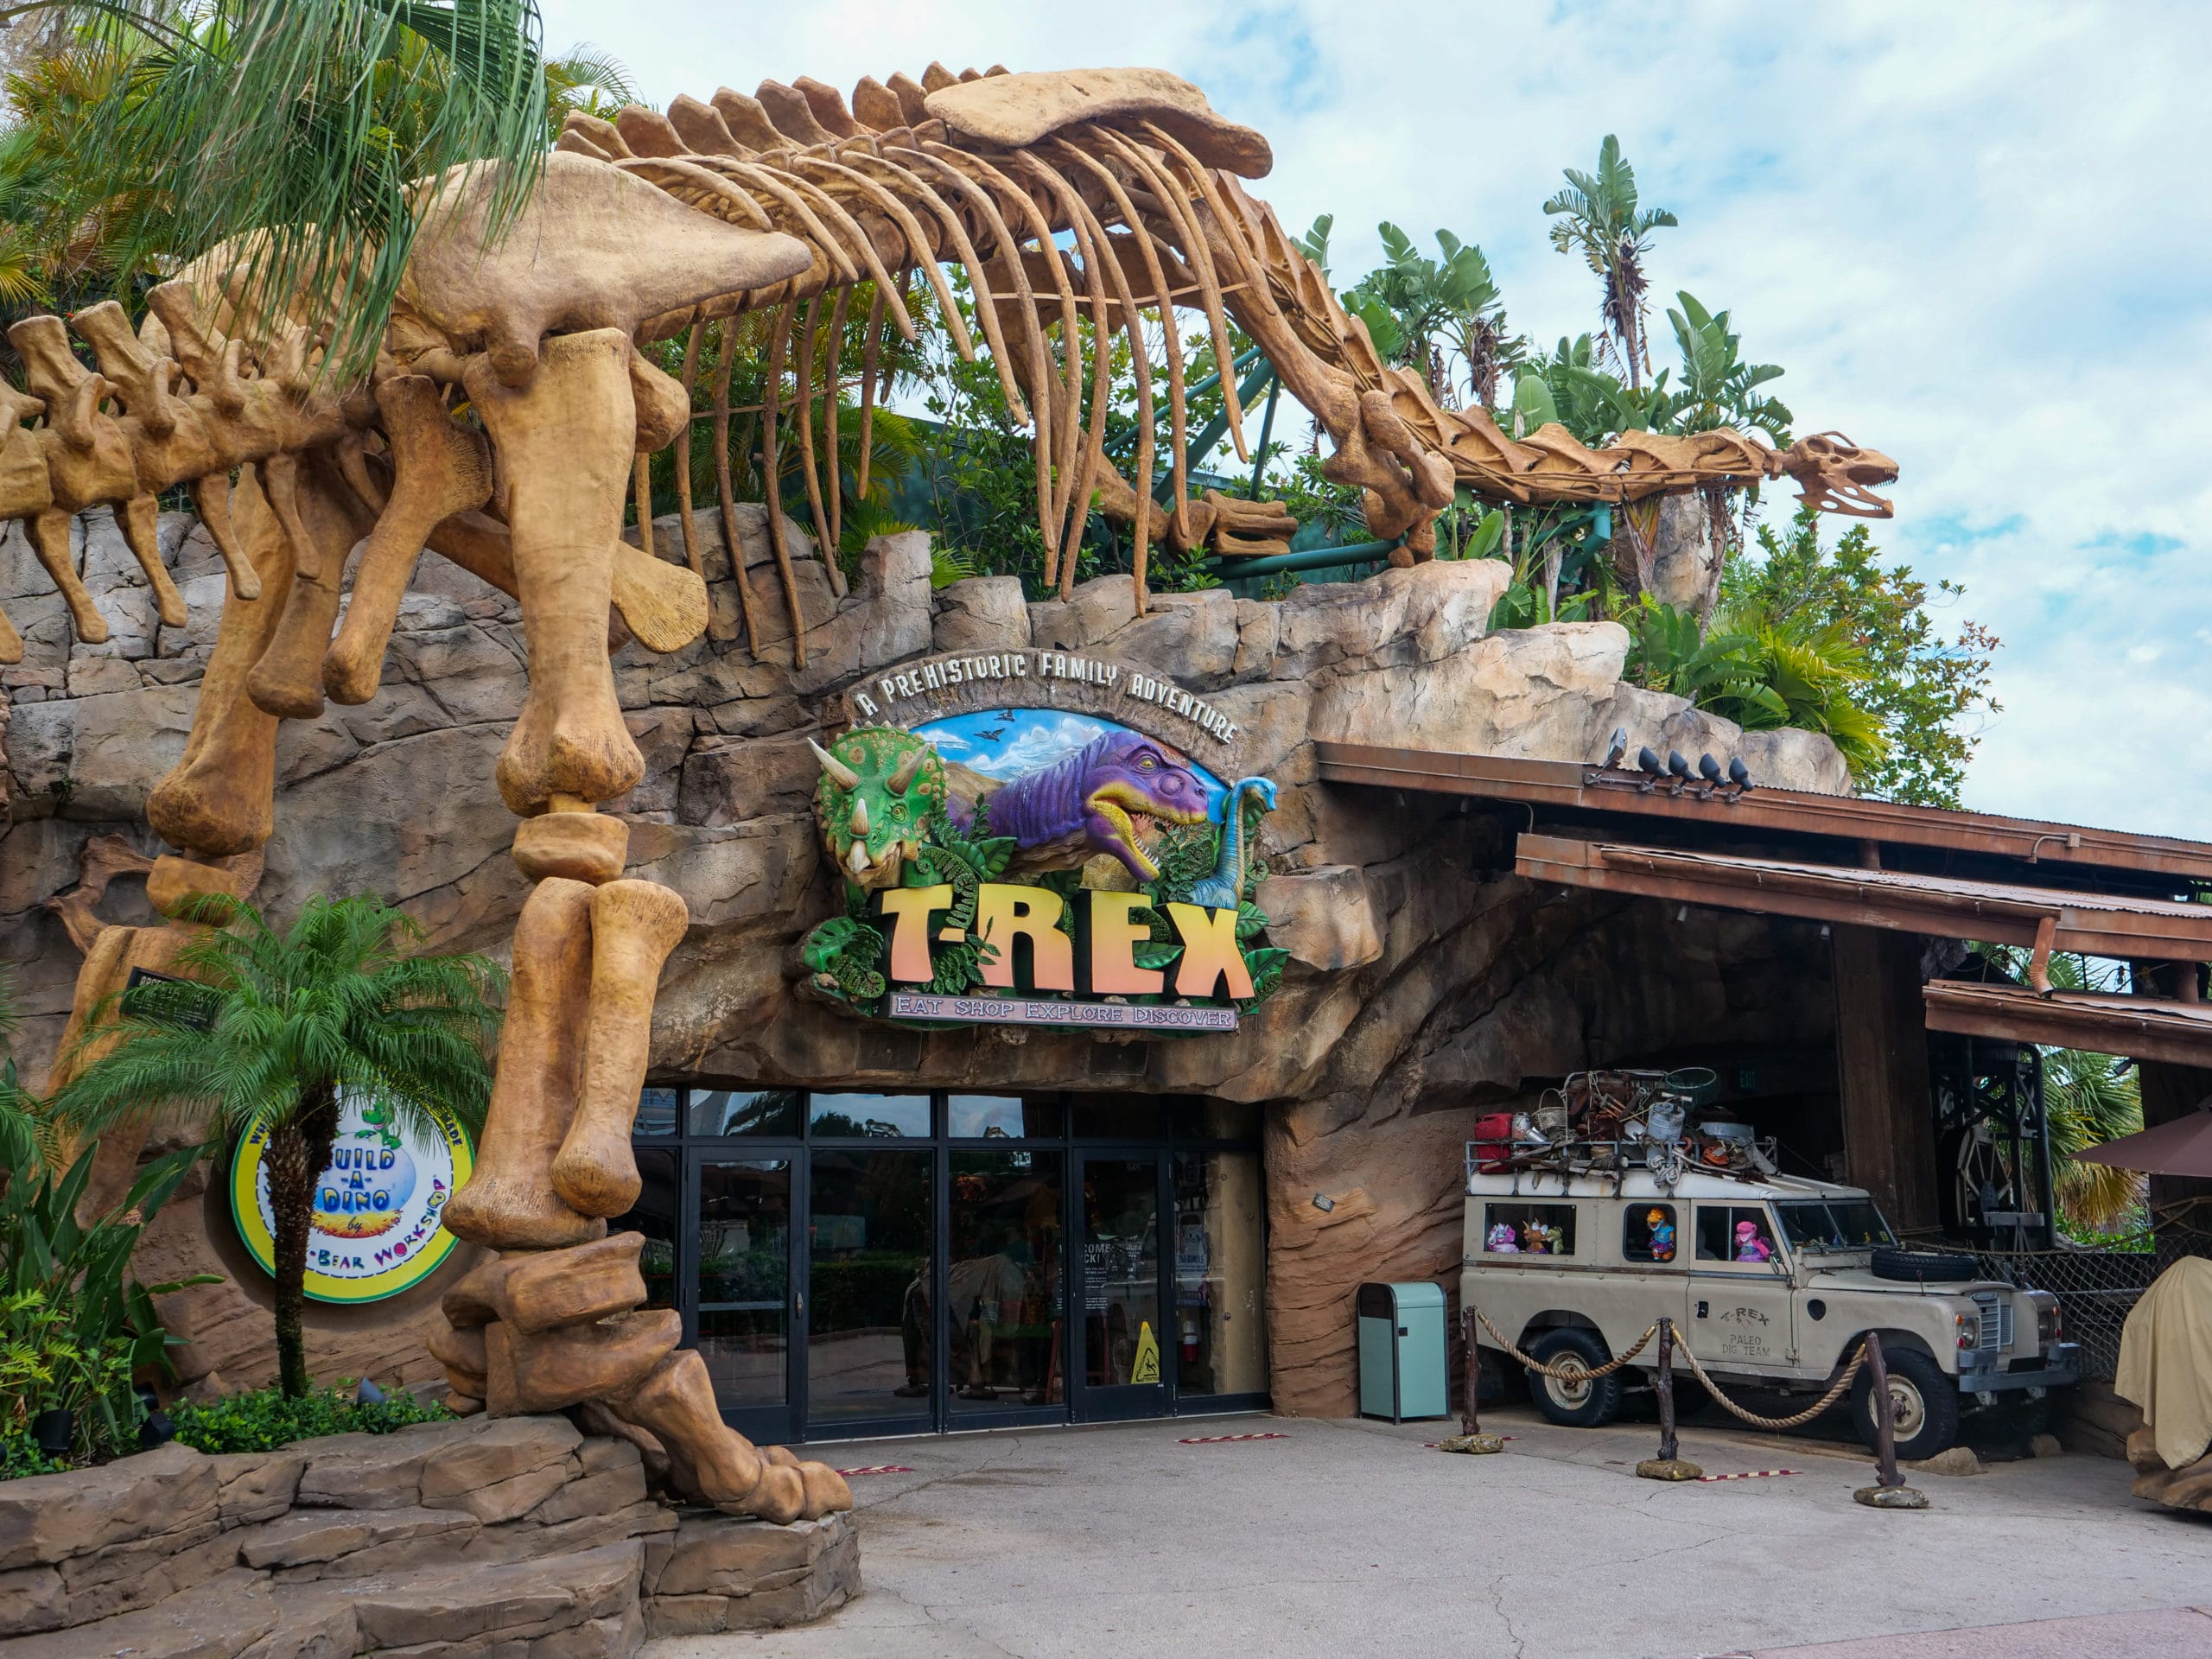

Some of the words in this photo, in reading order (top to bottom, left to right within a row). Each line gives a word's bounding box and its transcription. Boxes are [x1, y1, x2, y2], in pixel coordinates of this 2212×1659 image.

[855, 693, 879, 716] A
[877, 654, 1027, 704] PREHISTORIC
[1040, 652, 1118, 687] FAMILY
[1127, 672, 1239, 745] ADVENTURE
[880, 883, 1255, 1000] T-REX
[896, 996, 943, 1015] EAT
[954, 999, 1014, 1018] SHOP
[1026, 1001, 1122, 1022] EXPLORE
[1133, 1006, 1231, 1027] DISCOVER
[326, 1147, 395, 1171] UILD
[322, 1187, 389, 1213] DINO
[347, 1216, 363, 1235] by
[373, 1177, 446, 1268] WORKSHOP
[1722, 1344, 1738, 1355] DIG
[1744, 1345, 1770, 1357] TEAM
[1730, 1334, 1762, 1346] PALEO
